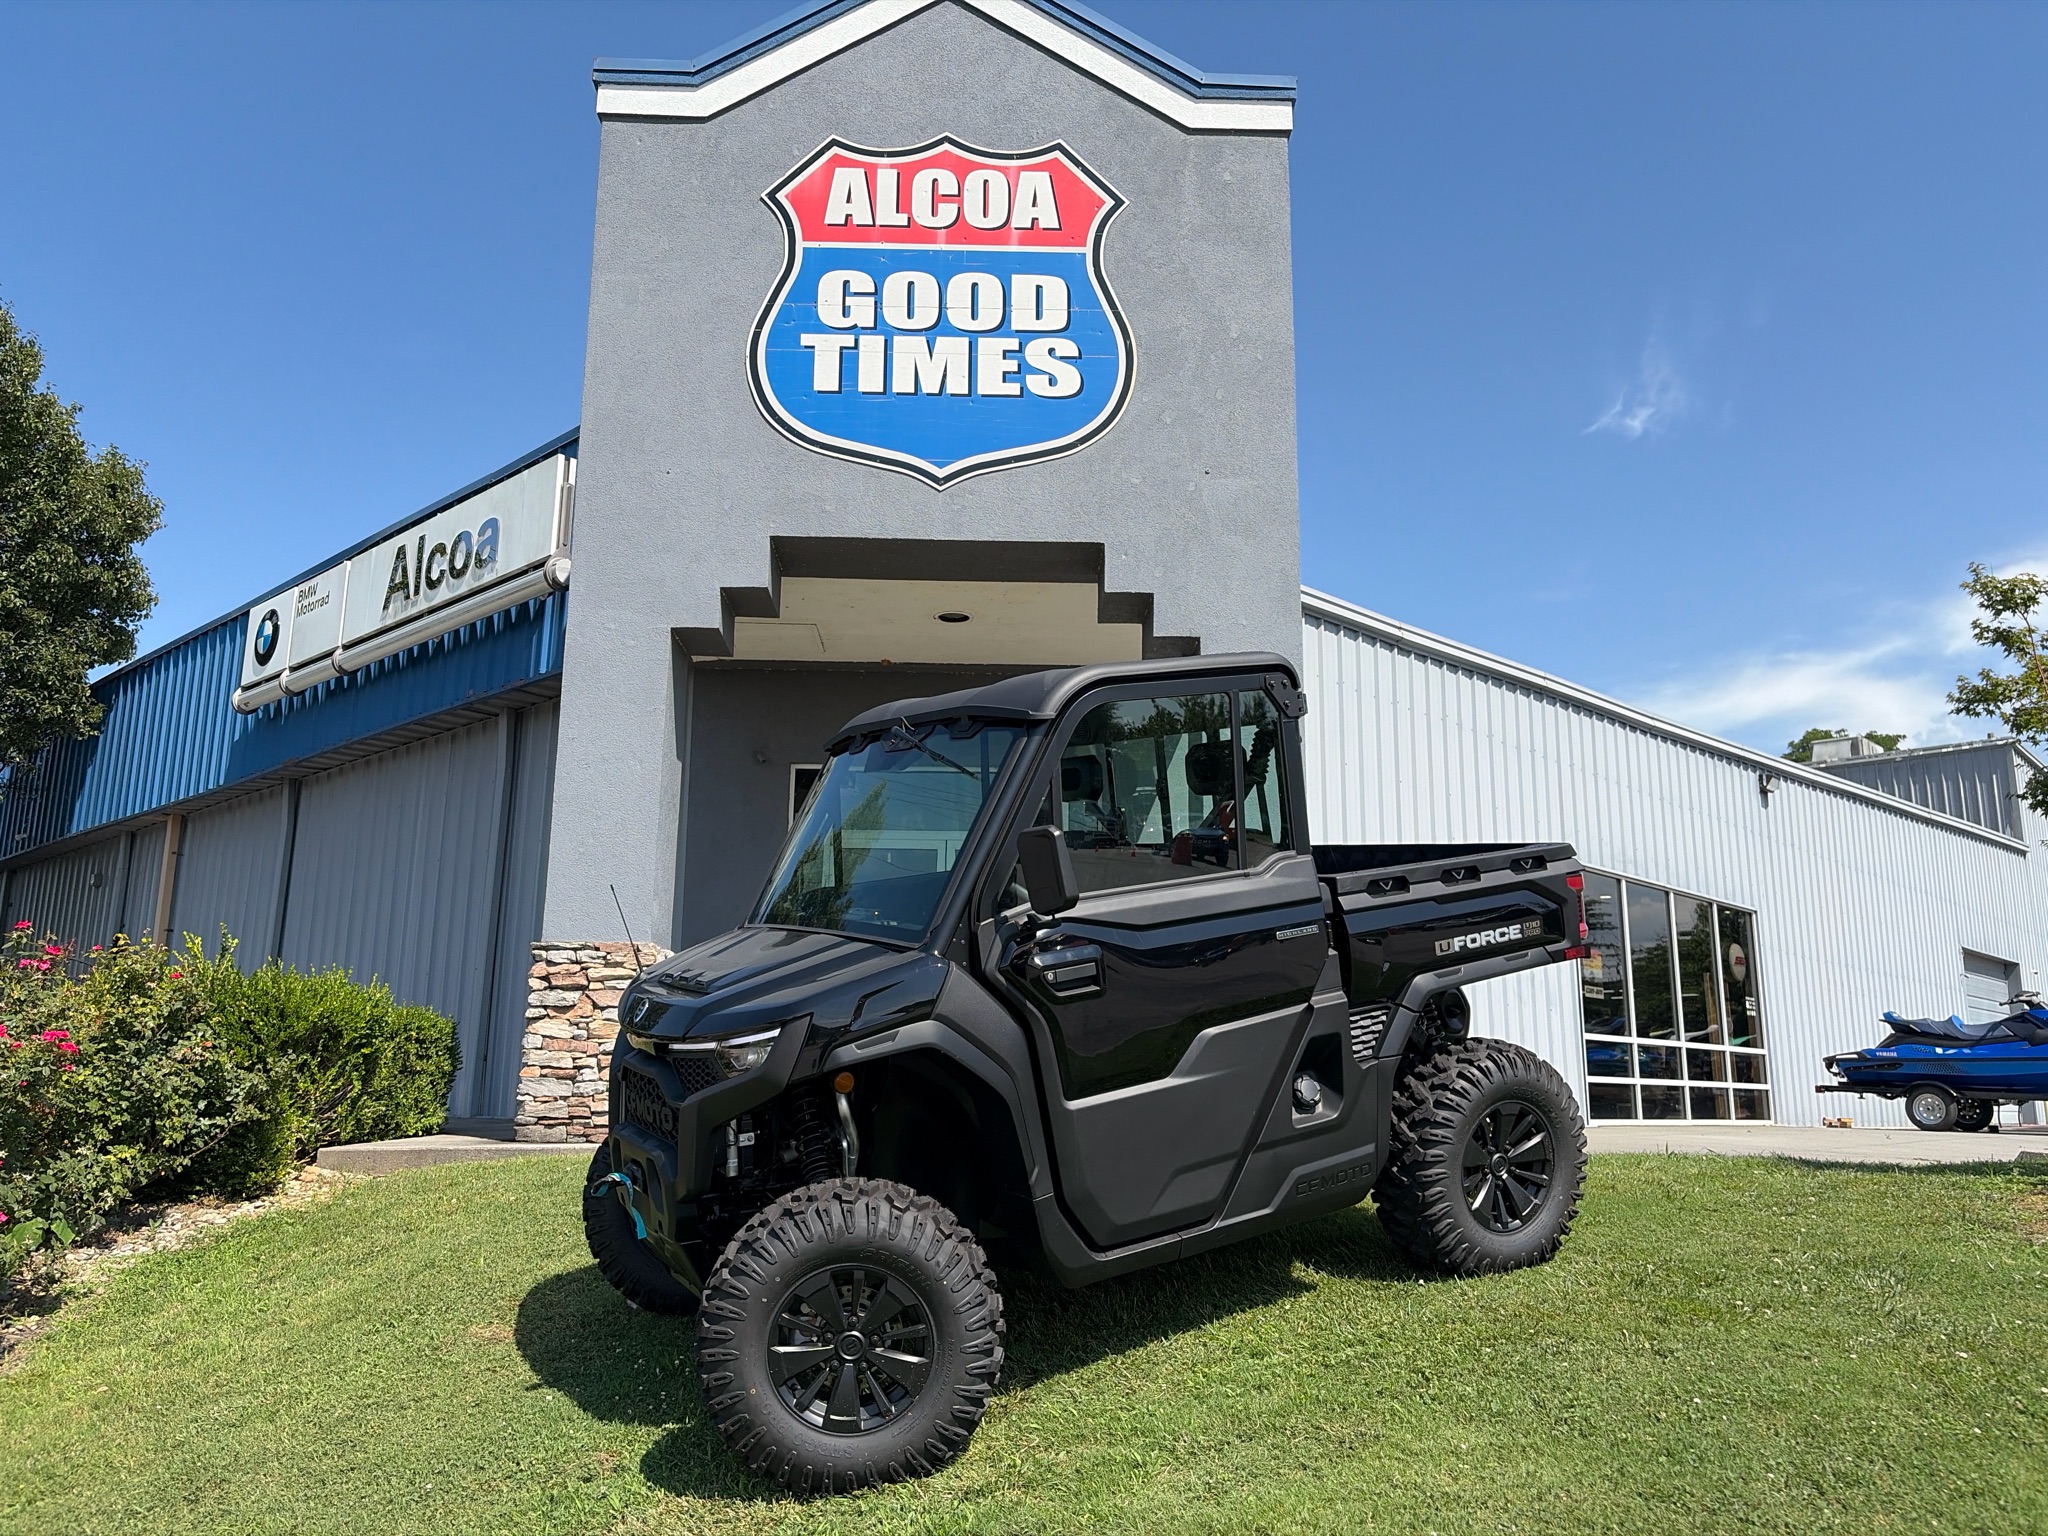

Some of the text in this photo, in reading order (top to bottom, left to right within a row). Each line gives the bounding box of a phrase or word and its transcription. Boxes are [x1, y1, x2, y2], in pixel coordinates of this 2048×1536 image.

[823, 168, 1061, 230] ALCOA
[817, 270, 1070, 333] GOOD
[801, 333, 1083, 398] TIMES
[382, 517, 499, 612] Alcoa
[296, 591, 330, 618] Motorrad
[298, 582, 318, 603] BMW
[1524, 928, 1541, 937] PRO
[1296, 1162, 1372, 1197] CFMOTO
